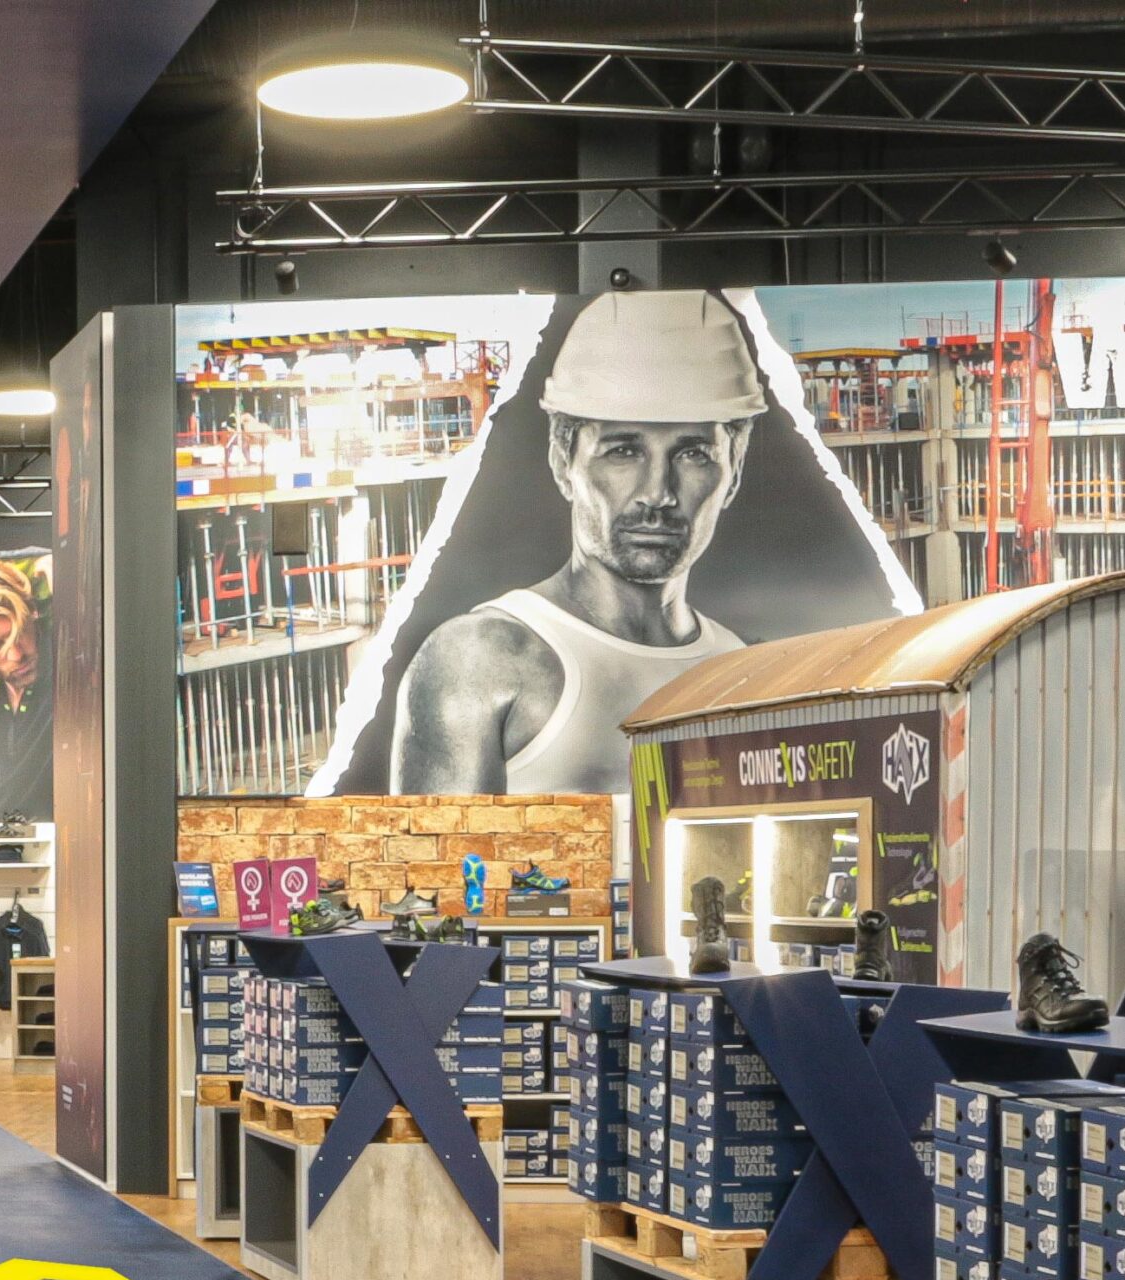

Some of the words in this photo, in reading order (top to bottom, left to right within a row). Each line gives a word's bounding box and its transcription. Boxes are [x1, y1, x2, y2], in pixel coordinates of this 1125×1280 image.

[739, 742, 806, 787] CONNEXIS
[808, 741, 856, 781] SAFETY
[725, 1055, 765, 1064] HERO
[726, 1101, 775, 1111] HEROES
[736, 1119, 778, 1131] HAIX
[724, 1146, 774, 1156] HEROES
[734, 1163, 777, 1177] HAIX
[723, 1193, 773, 1203] HEROES
[732, 1210, 775, 1223] HAIX
